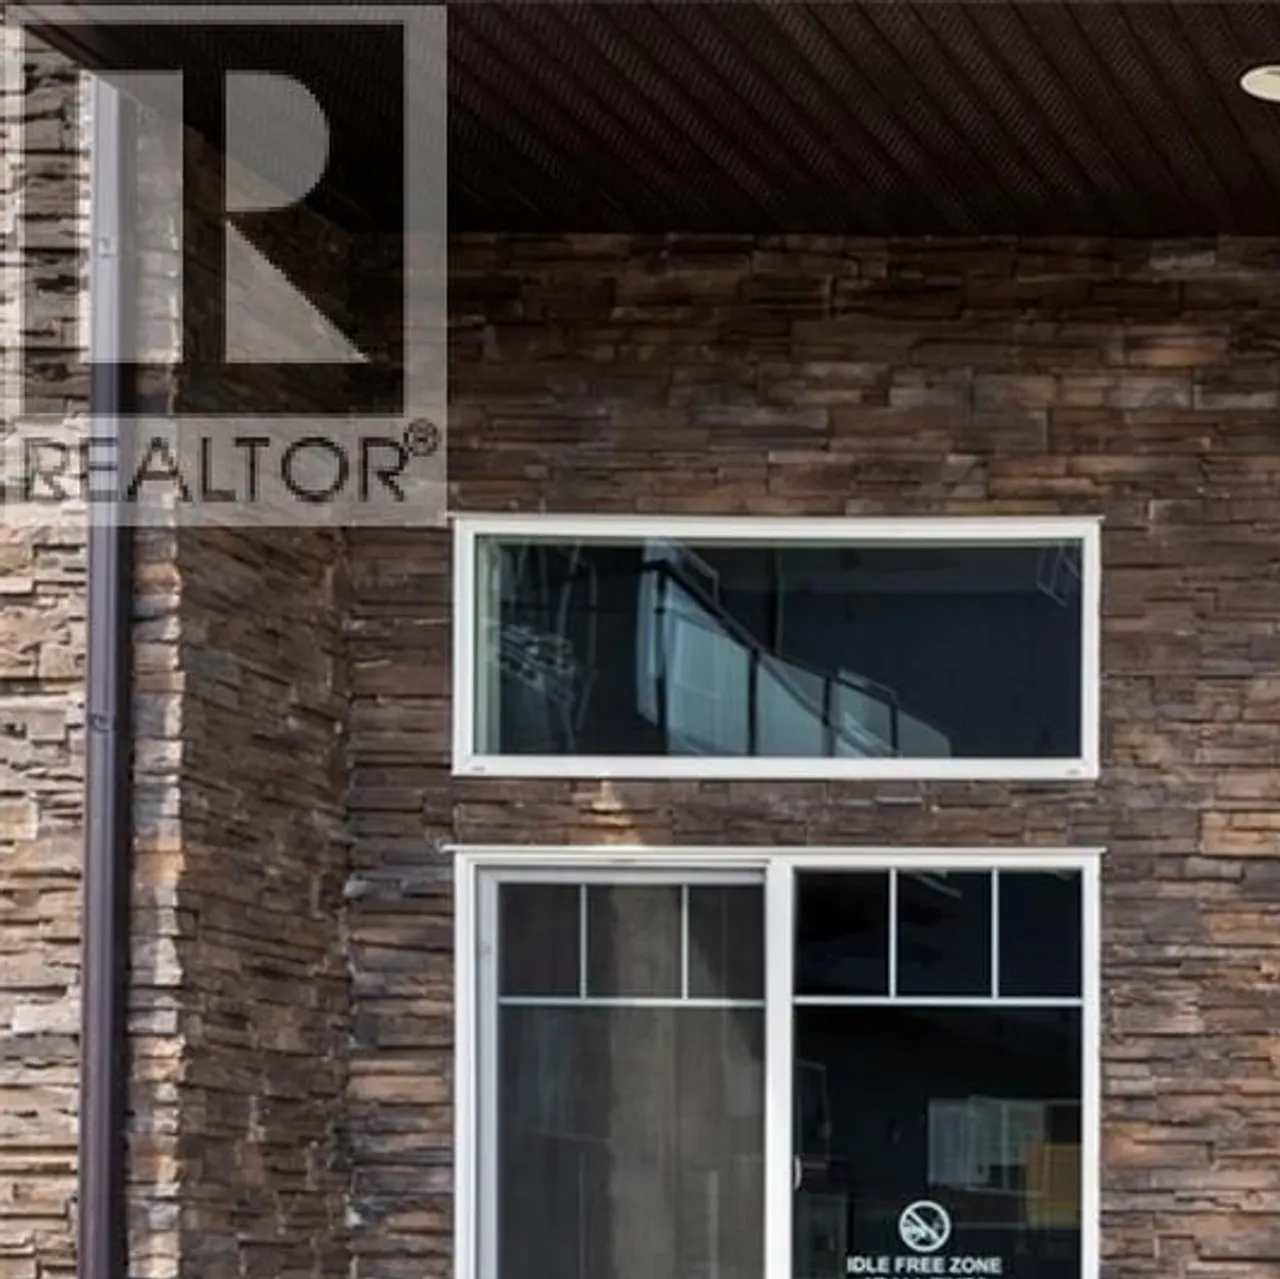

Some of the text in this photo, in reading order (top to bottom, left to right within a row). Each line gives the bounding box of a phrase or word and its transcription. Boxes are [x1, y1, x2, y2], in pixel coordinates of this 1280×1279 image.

[846, 1256, 1002, 1274] IDLE FREE ZONE
